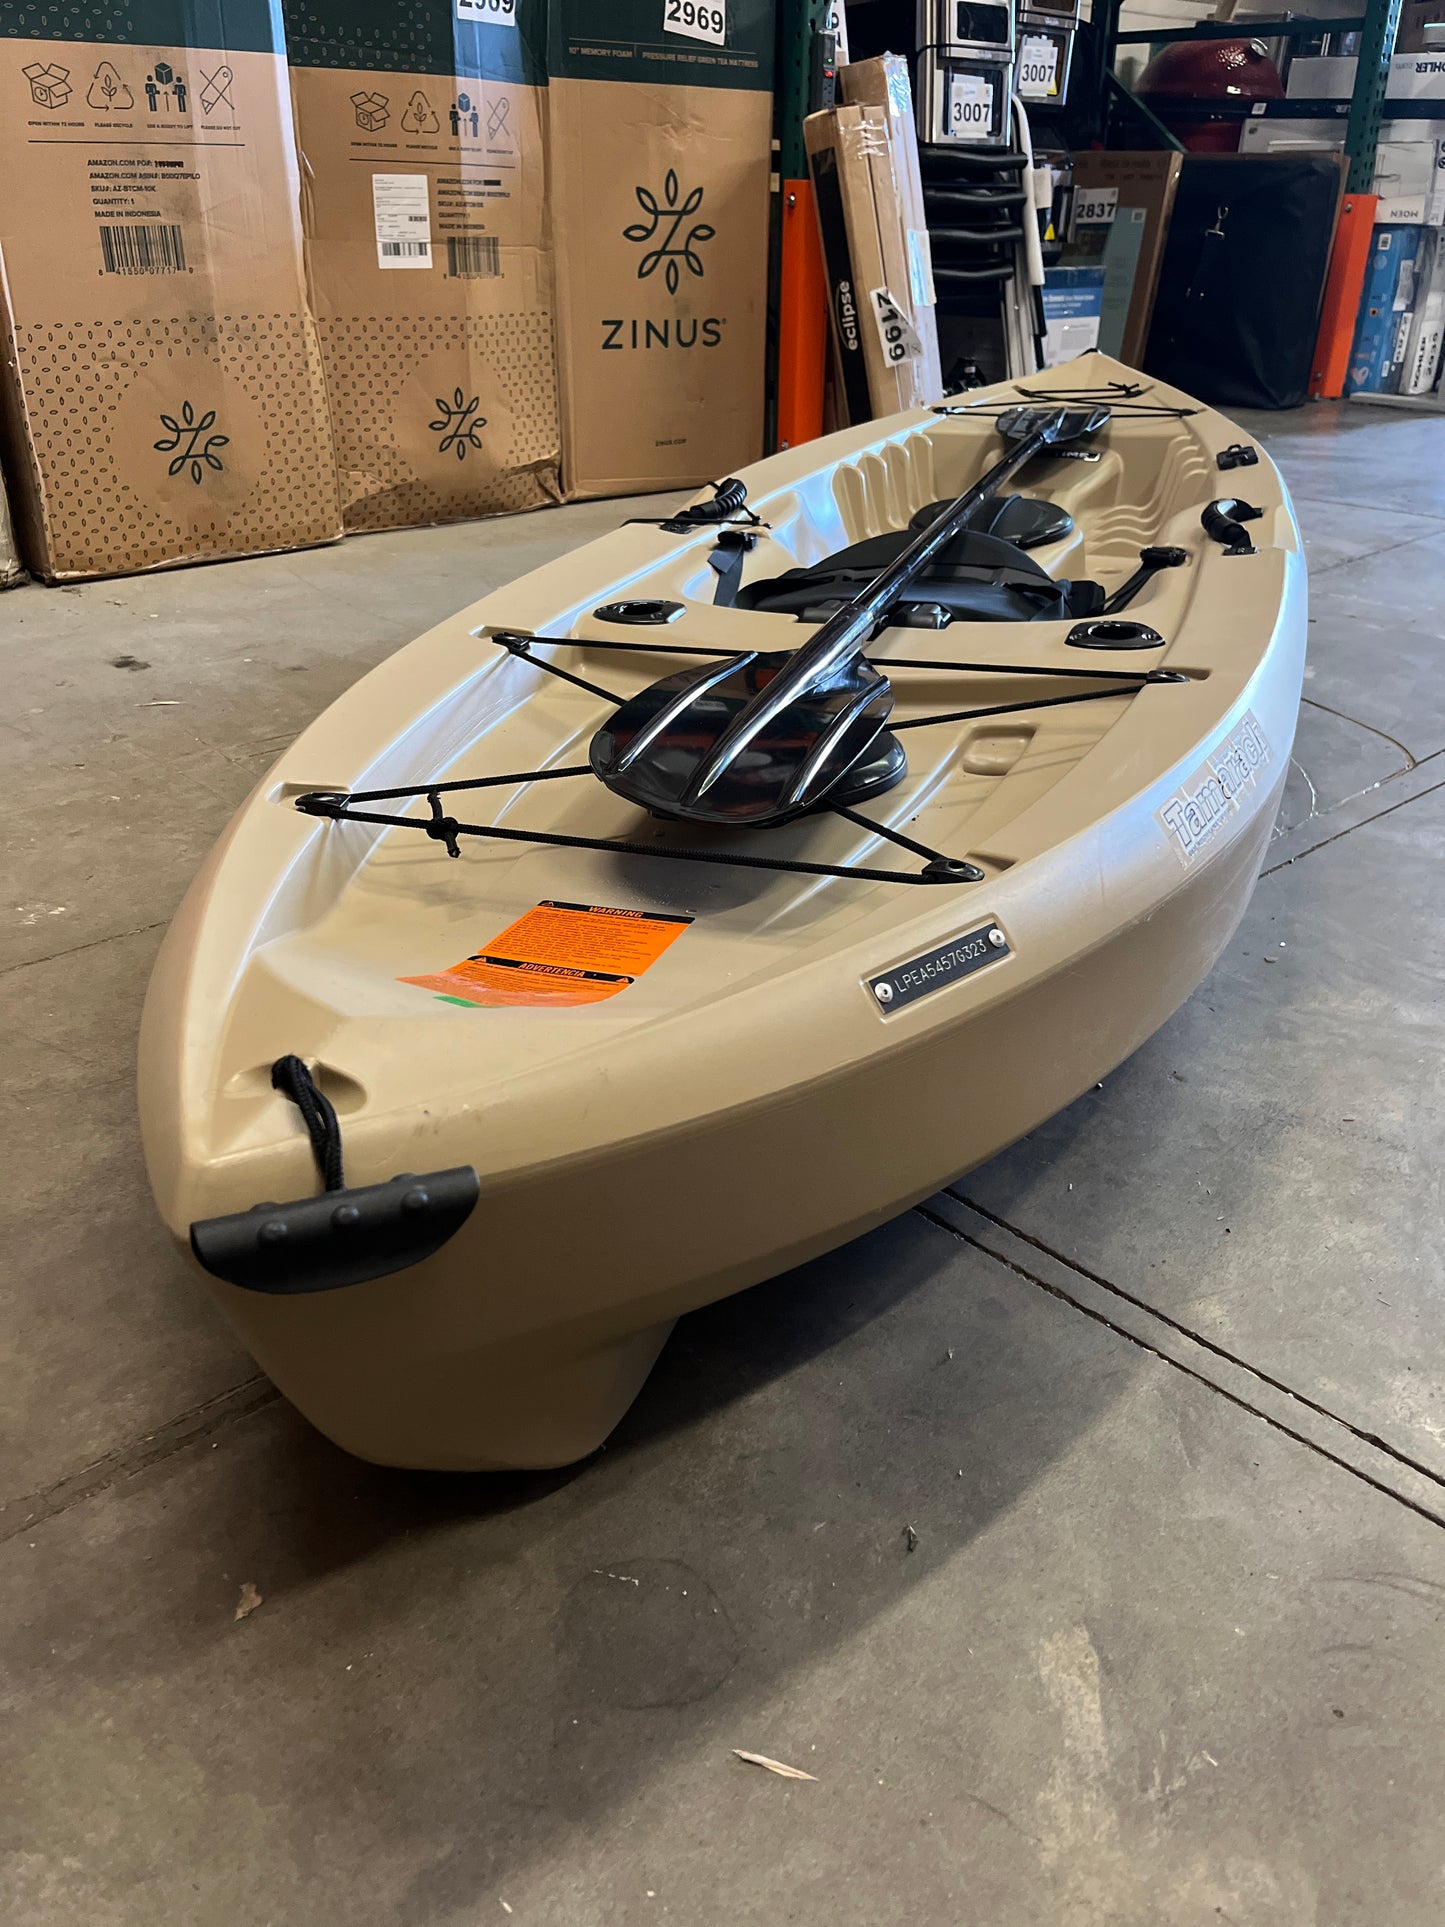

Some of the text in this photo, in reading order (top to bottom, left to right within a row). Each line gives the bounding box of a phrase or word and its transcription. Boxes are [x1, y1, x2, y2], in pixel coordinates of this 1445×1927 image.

[666, 0, 723, 34] 2969
[580, 47, 611, 57] MEMORY
[612, 50, 633, 58] FOAM
[1022, 63, 1054, 82] 3007
[953, 102, 990, 122] 3007
[87, 159, 137, 167] AMAZON.COM
[92, 197, 130, 205] QUANTITY:
[94, 210, 115, 218] MADE
[124, 210, 162, 218] INDONESIA
[1076, 202, 1116, 218] 2837
[1390, 210, 1419, 219] MOEN
[839, 280, 859, 351] eclipse
[601, 318, 721, 350] ZINUS
[588, 905, 644, 918] WARNING
[518, 962, 586, 978] ADVERTENCIA
[894, 938, 987, 993] LPEA5457G323
